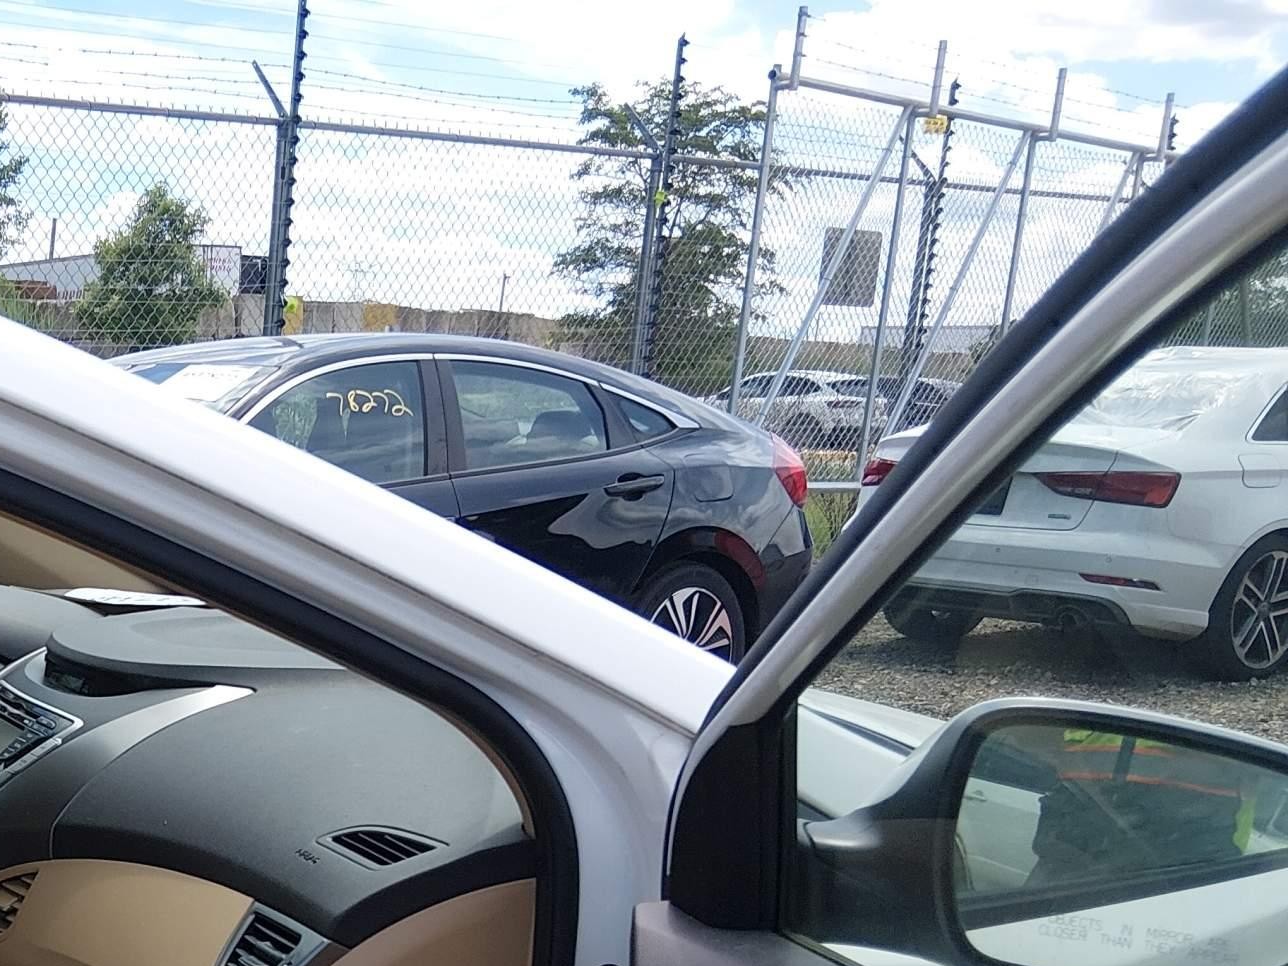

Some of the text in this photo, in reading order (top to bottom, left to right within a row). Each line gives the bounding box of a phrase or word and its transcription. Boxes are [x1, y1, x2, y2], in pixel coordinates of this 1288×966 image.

[326, 389, 414, 416] 78272
[1038, 923, 1089, 941] CLOSER
[1101, 933, 1132, 950] THAN
[1145, 927, 1193, 945] MIRROR
